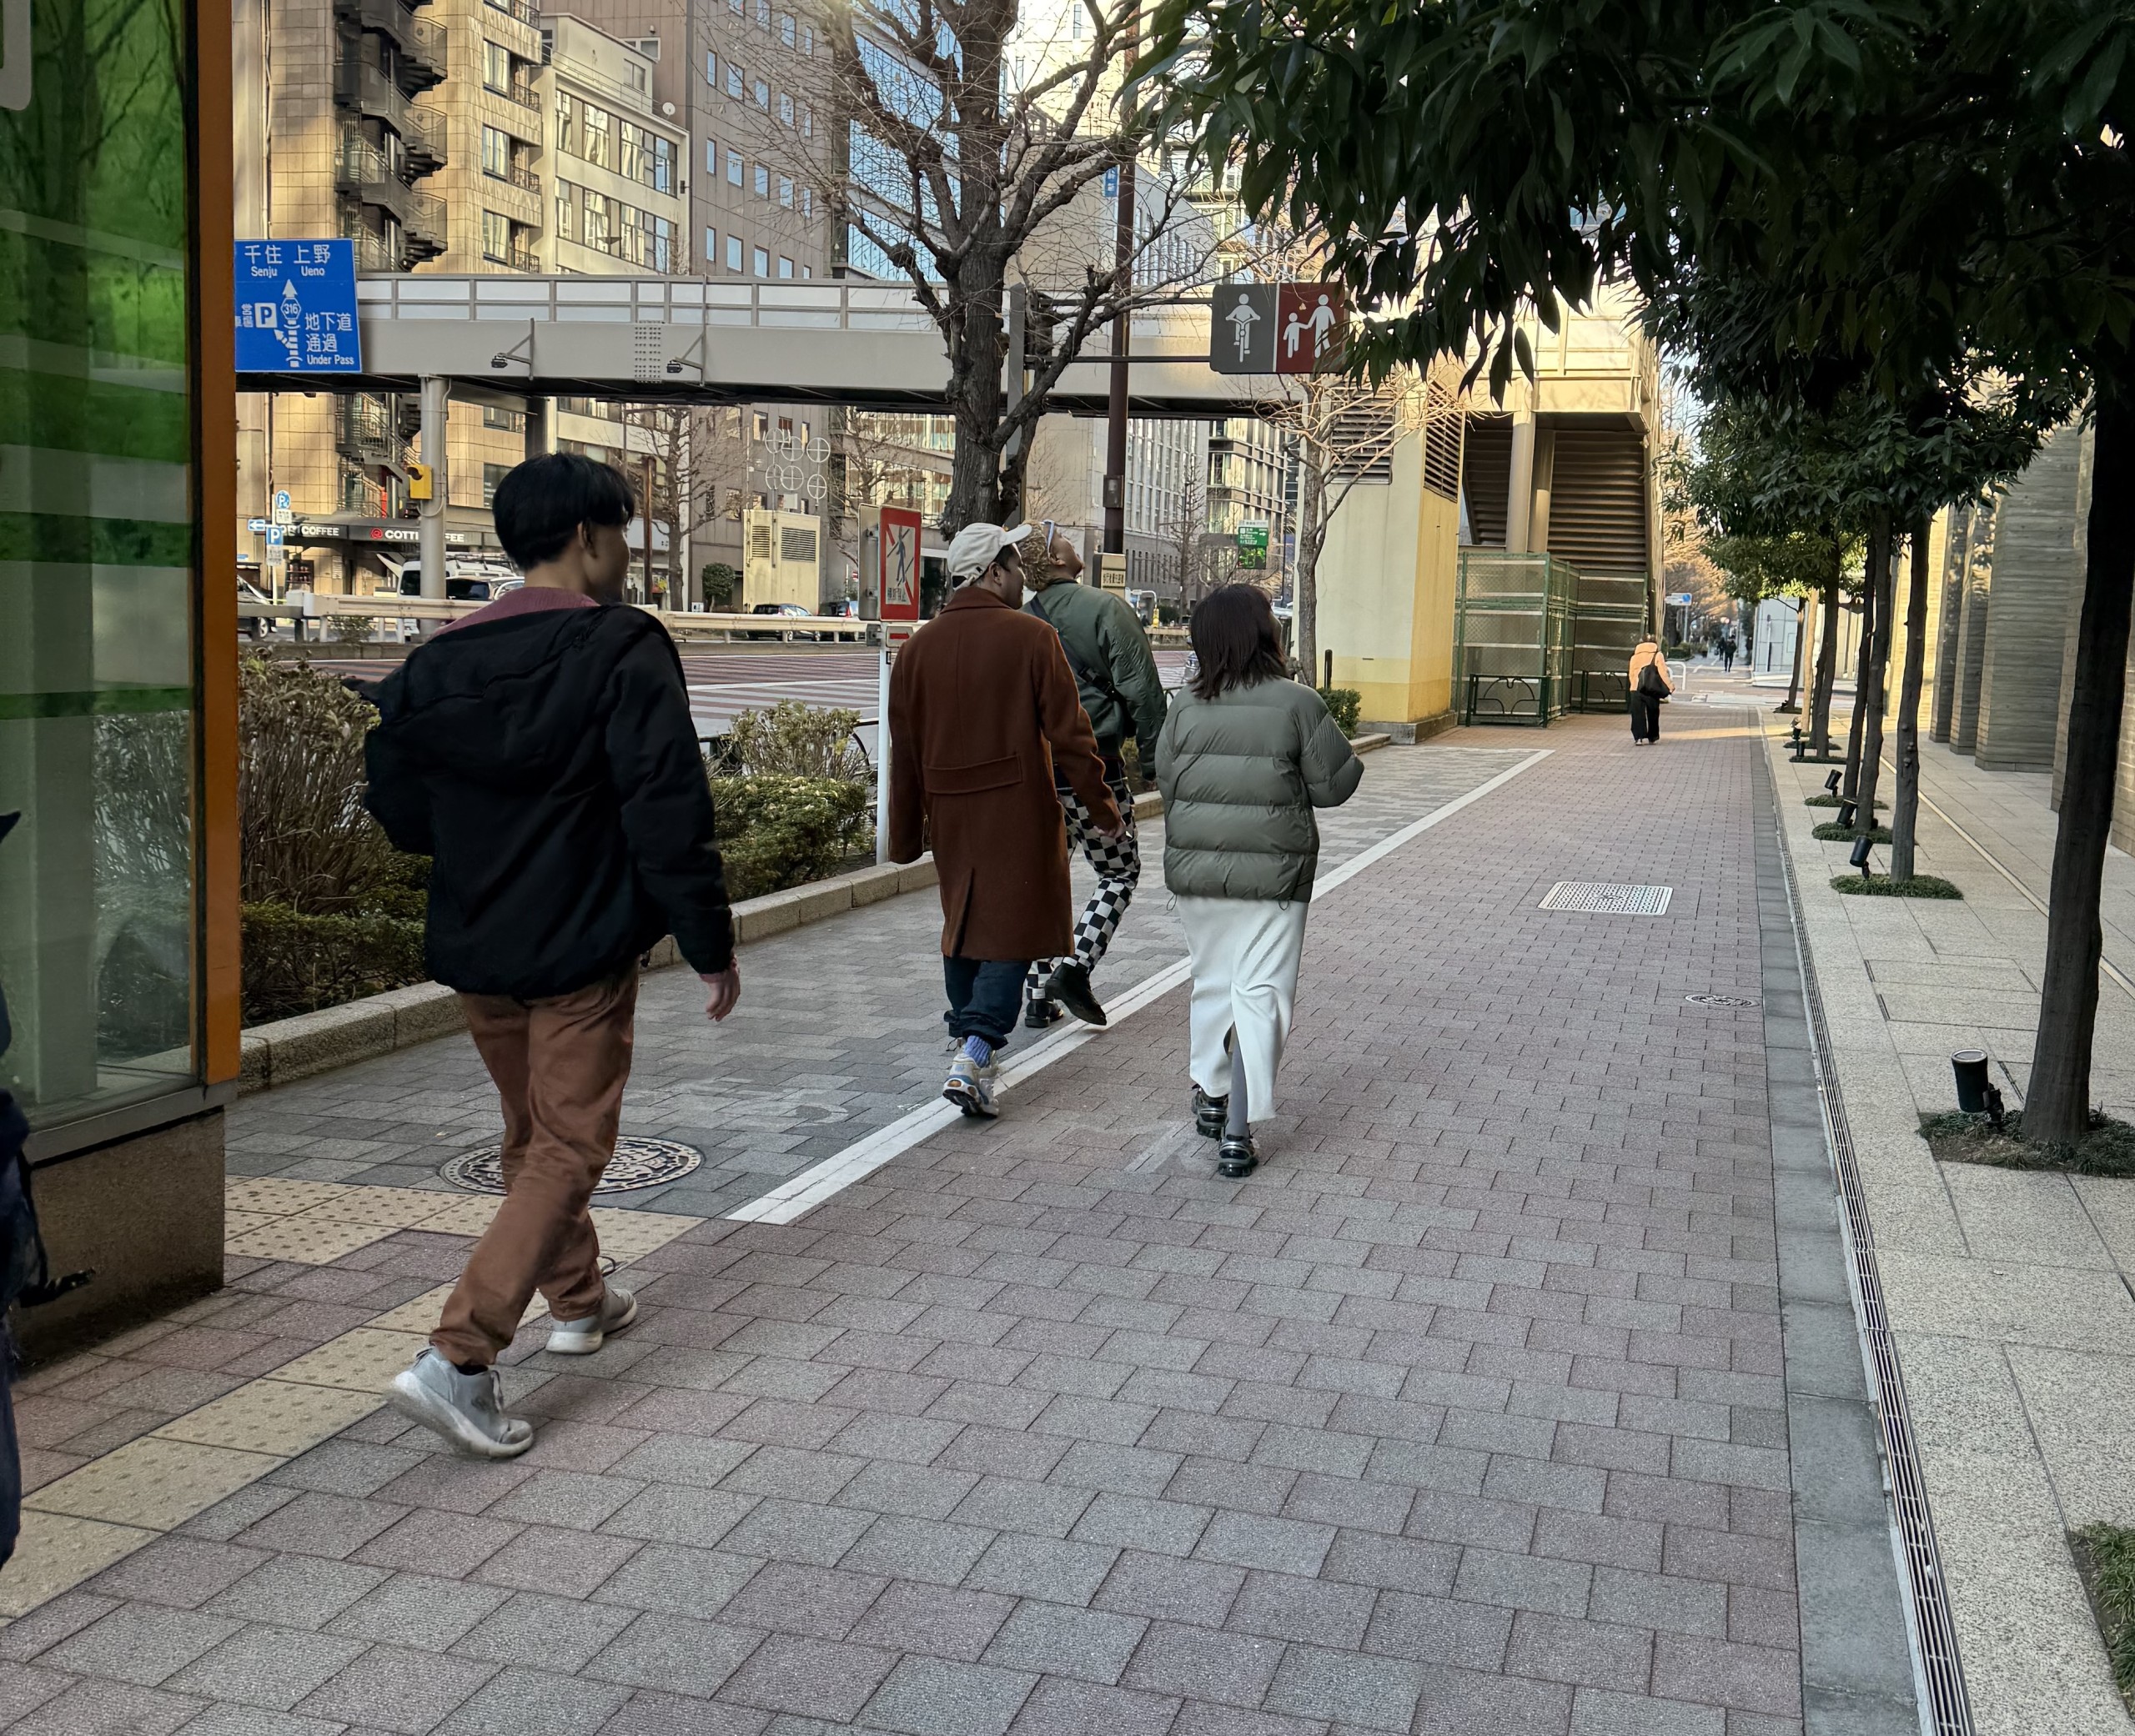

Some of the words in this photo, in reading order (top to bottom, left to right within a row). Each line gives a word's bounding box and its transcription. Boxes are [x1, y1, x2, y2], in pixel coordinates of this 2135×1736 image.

[244, 244, 283, 264] 千住
[294, 244, 331, 264] 上野
[251, 266, 278, 278] Senju
[301, 265, 325, 277] Ueno
[260, 306, 273, 325] P
[284, 303, 299, 314] 316
[304, 312, 353, 331] 地下道
[305, 333, 338, 352] 通過
[307, 354, 331, 364] Under
[334, 354, 354, 364] Pass
[270, 529, 281, 544] P
[301, 525, 339, 536] COFFEE
[384, 529, 419, 540] COTTI
